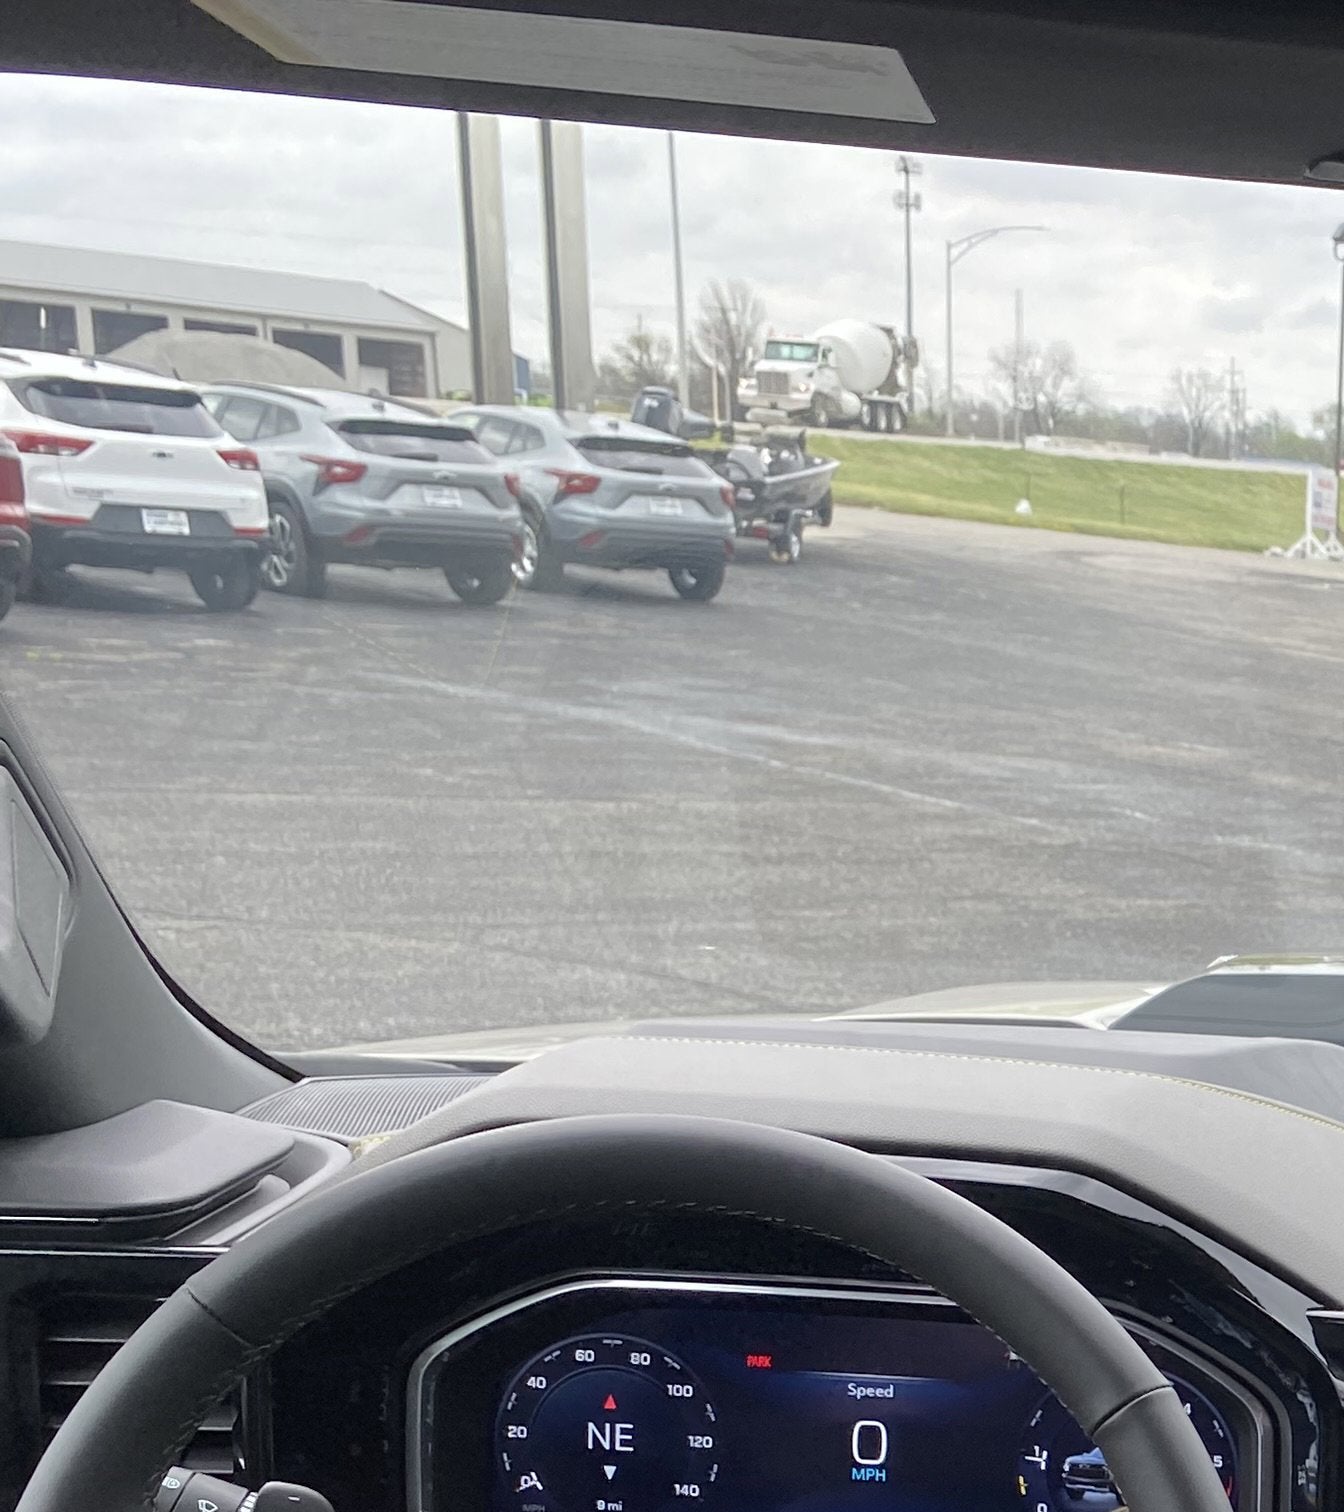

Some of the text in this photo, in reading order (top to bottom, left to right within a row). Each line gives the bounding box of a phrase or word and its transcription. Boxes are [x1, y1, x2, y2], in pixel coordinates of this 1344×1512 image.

[575, 1350, 595, 1362] 60
[630, 1353, 650, 1366] 80
[746, 1355, 772, 1368] PARK
[527, 1377, 547, 1389] 40
[667, 1384, 693, 1397] 100
[847, 1383, 894, 1400] Speed
[507, 1426, 528, 1438] 20
[587, 1422, 634, 1452] NE
[688, 1435, 713, 1448] 120
[852, 1420, 888, 1465] 0
[1213, 1455, 1223, 1468] 5
[852, 1468, 886, 1482] MPH
[674, 1484, 700, 1497] 140
[607, 1501, 623, 1512] mi
